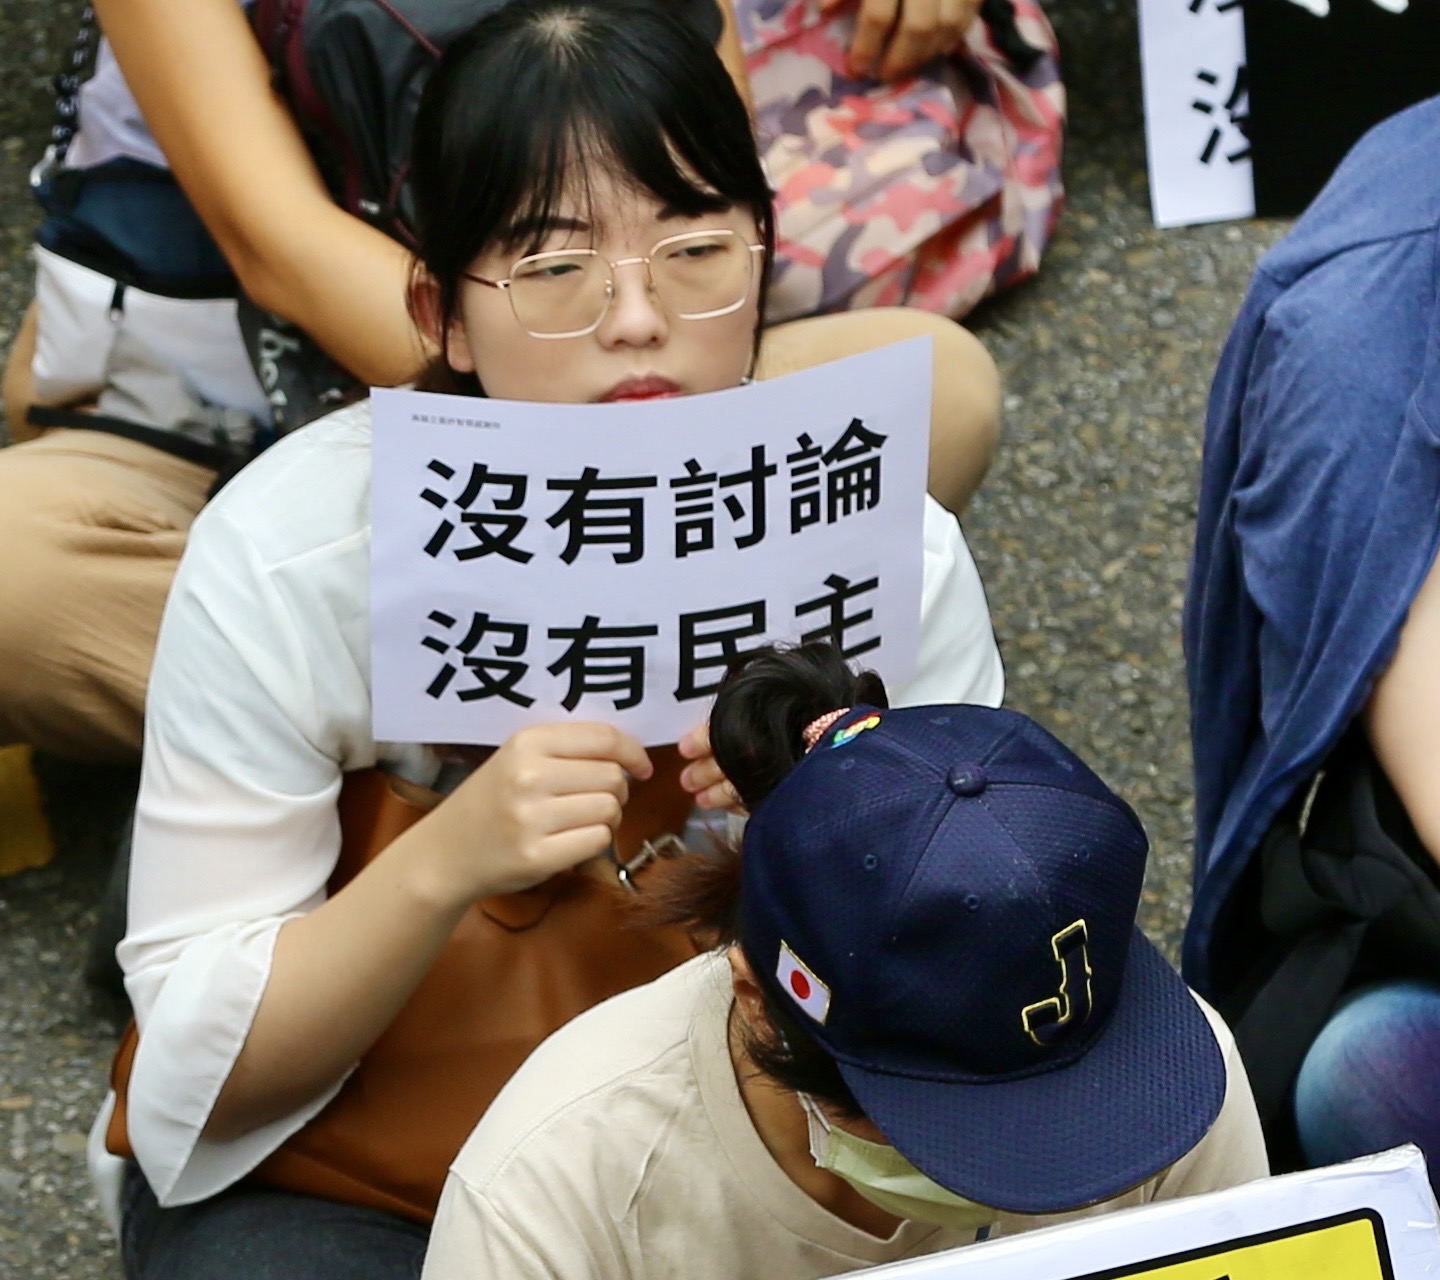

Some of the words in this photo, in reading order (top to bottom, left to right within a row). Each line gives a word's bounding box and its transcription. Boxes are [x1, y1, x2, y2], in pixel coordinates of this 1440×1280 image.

[418, 417, 888, 565] 沒有討論
[421, 573, 883, 712] 沒有民主
